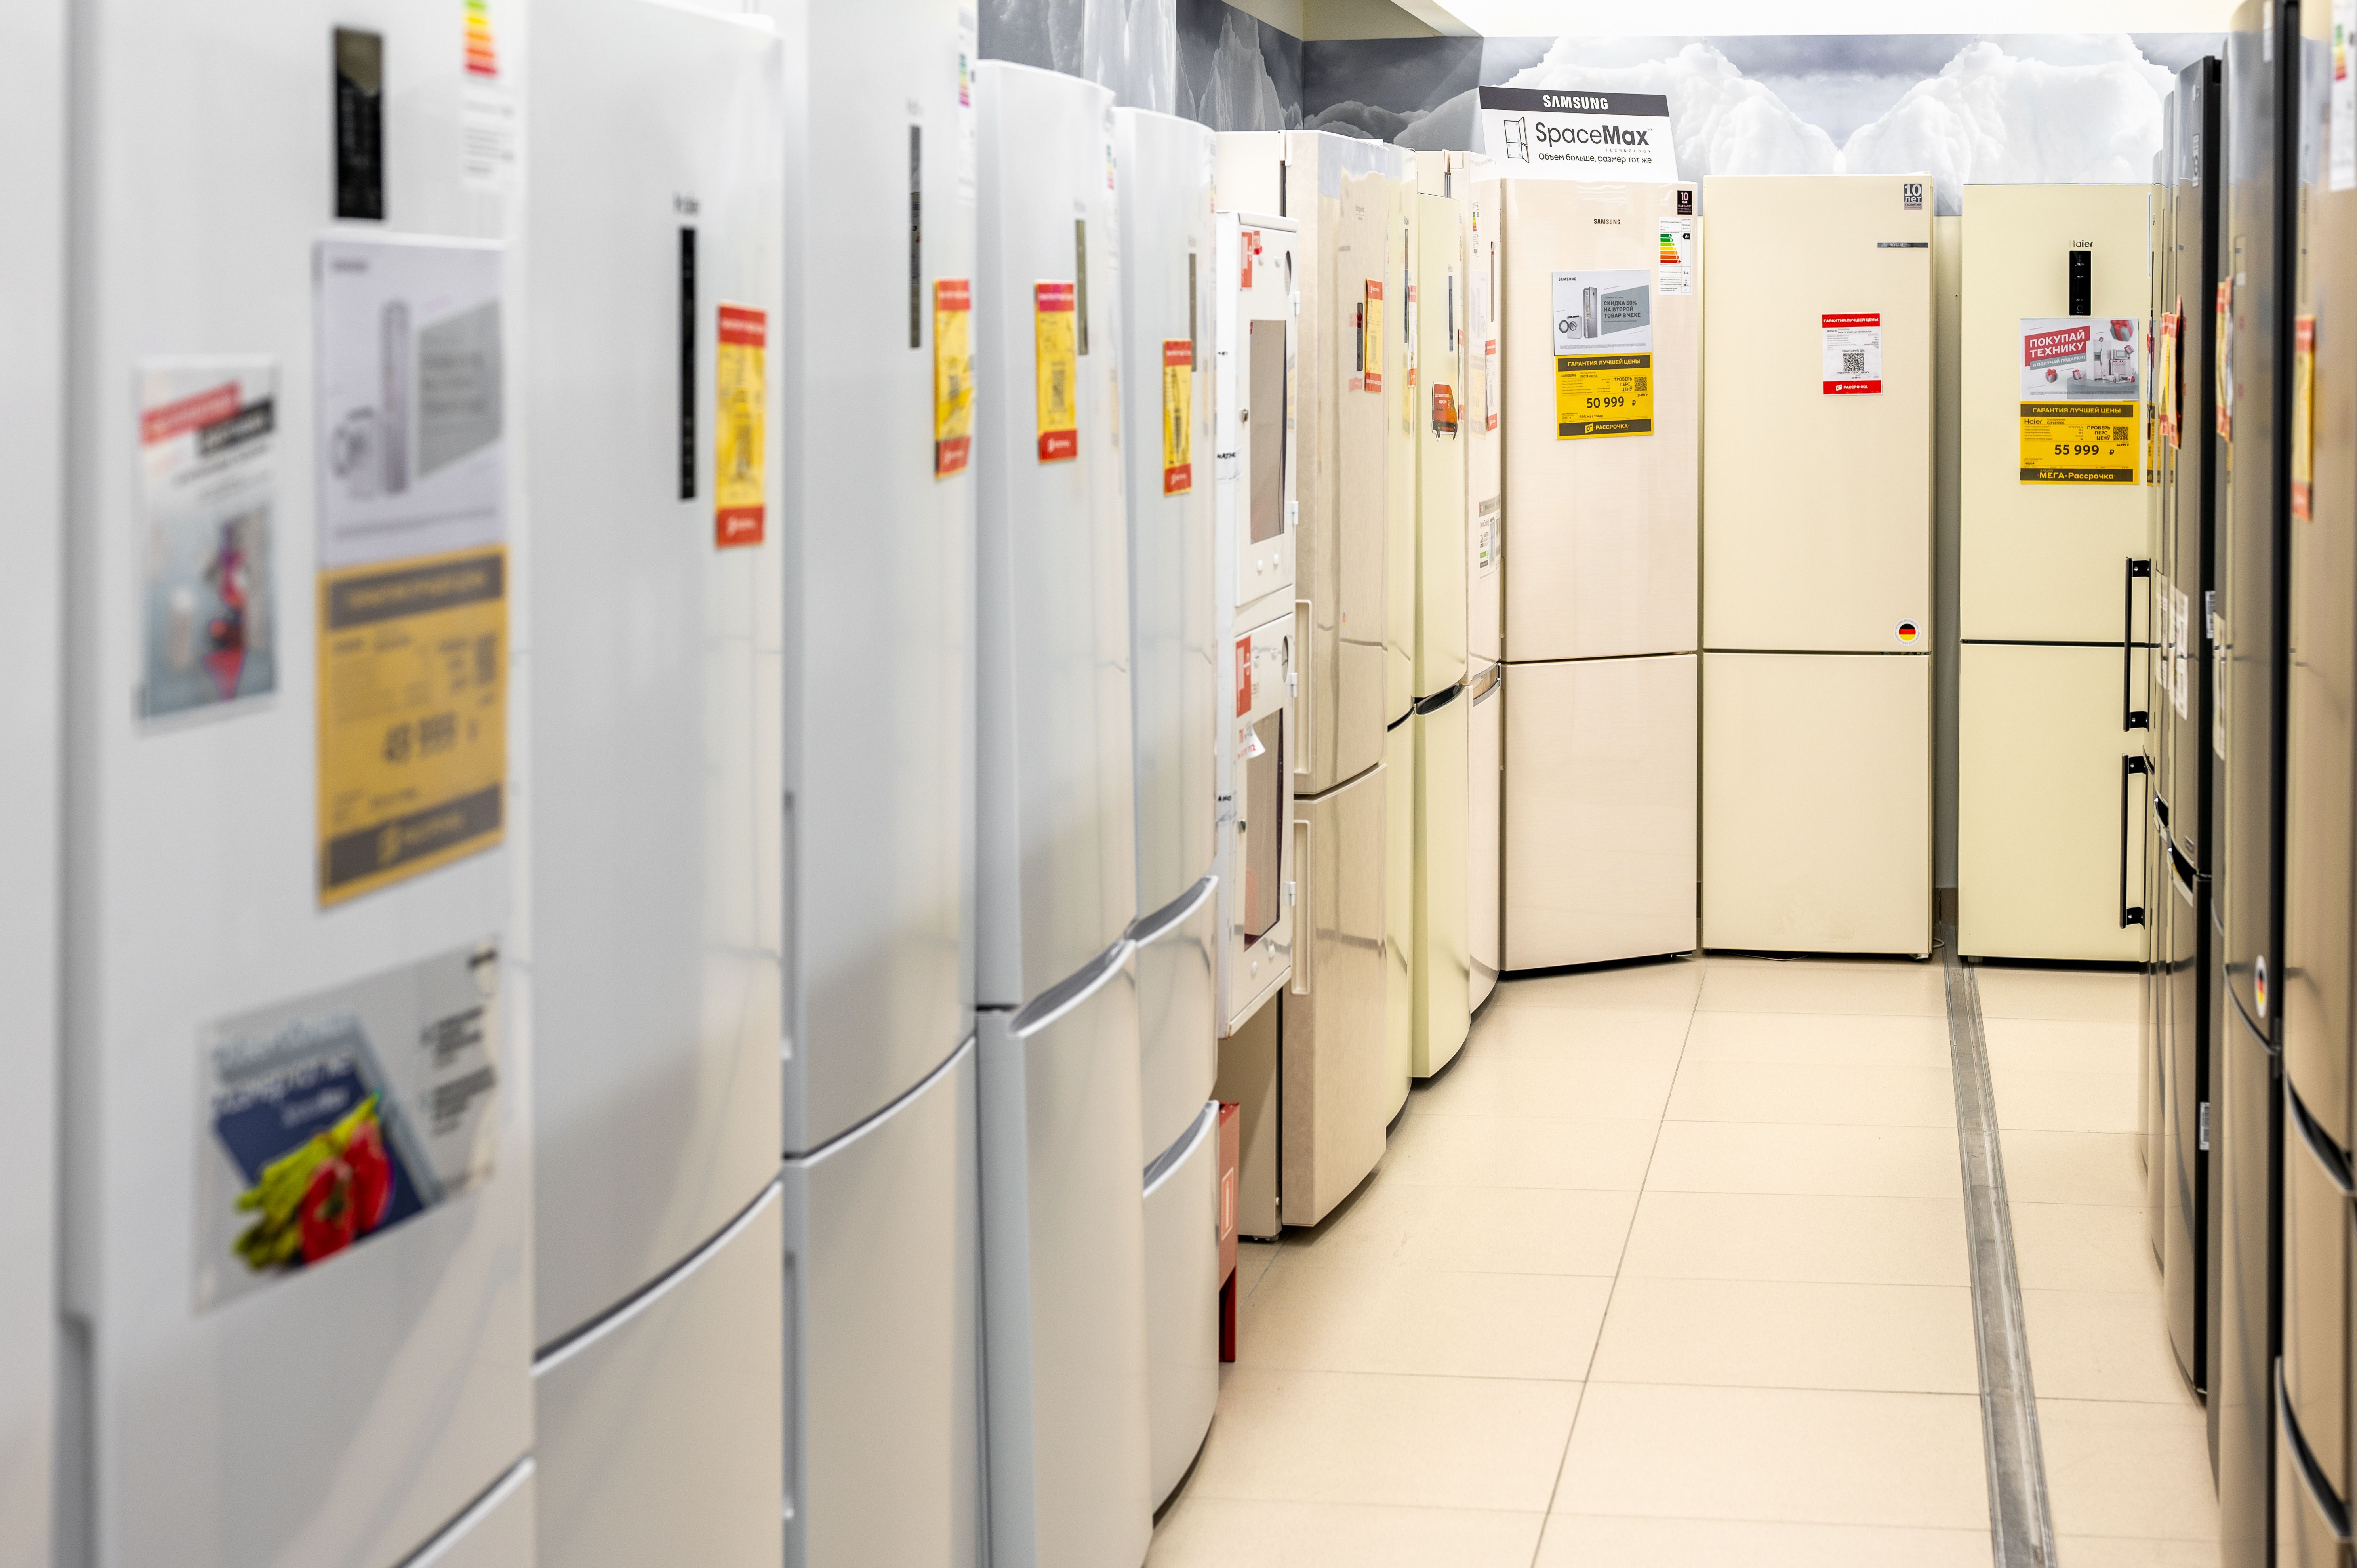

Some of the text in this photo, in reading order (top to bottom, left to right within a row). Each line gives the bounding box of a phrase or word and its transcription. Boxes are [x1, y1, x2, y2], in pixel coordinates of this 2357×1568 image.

[1543, 95, 1608, 110] SAMSUNG
[1566, 154, 1596, 162] больше,
[1598, 156, 1626, 164] размер
[1681, 192, 1688, 200] 10
[1905, 184, 1921, 196] 10
[2030, 329, 2085, 348] ПОКУПАЙ
[2029, 341, 2084, 358] ТЕХНИКУ
[1587, 397, 1600, 408] 50
[1604, 396, 1624, 407] 999
[2054, 444, 2070, 455] 55
[2074, 444, 2099, 455] 999
[2039, 472, 2114, 480] МЕГА-Рассрочка
